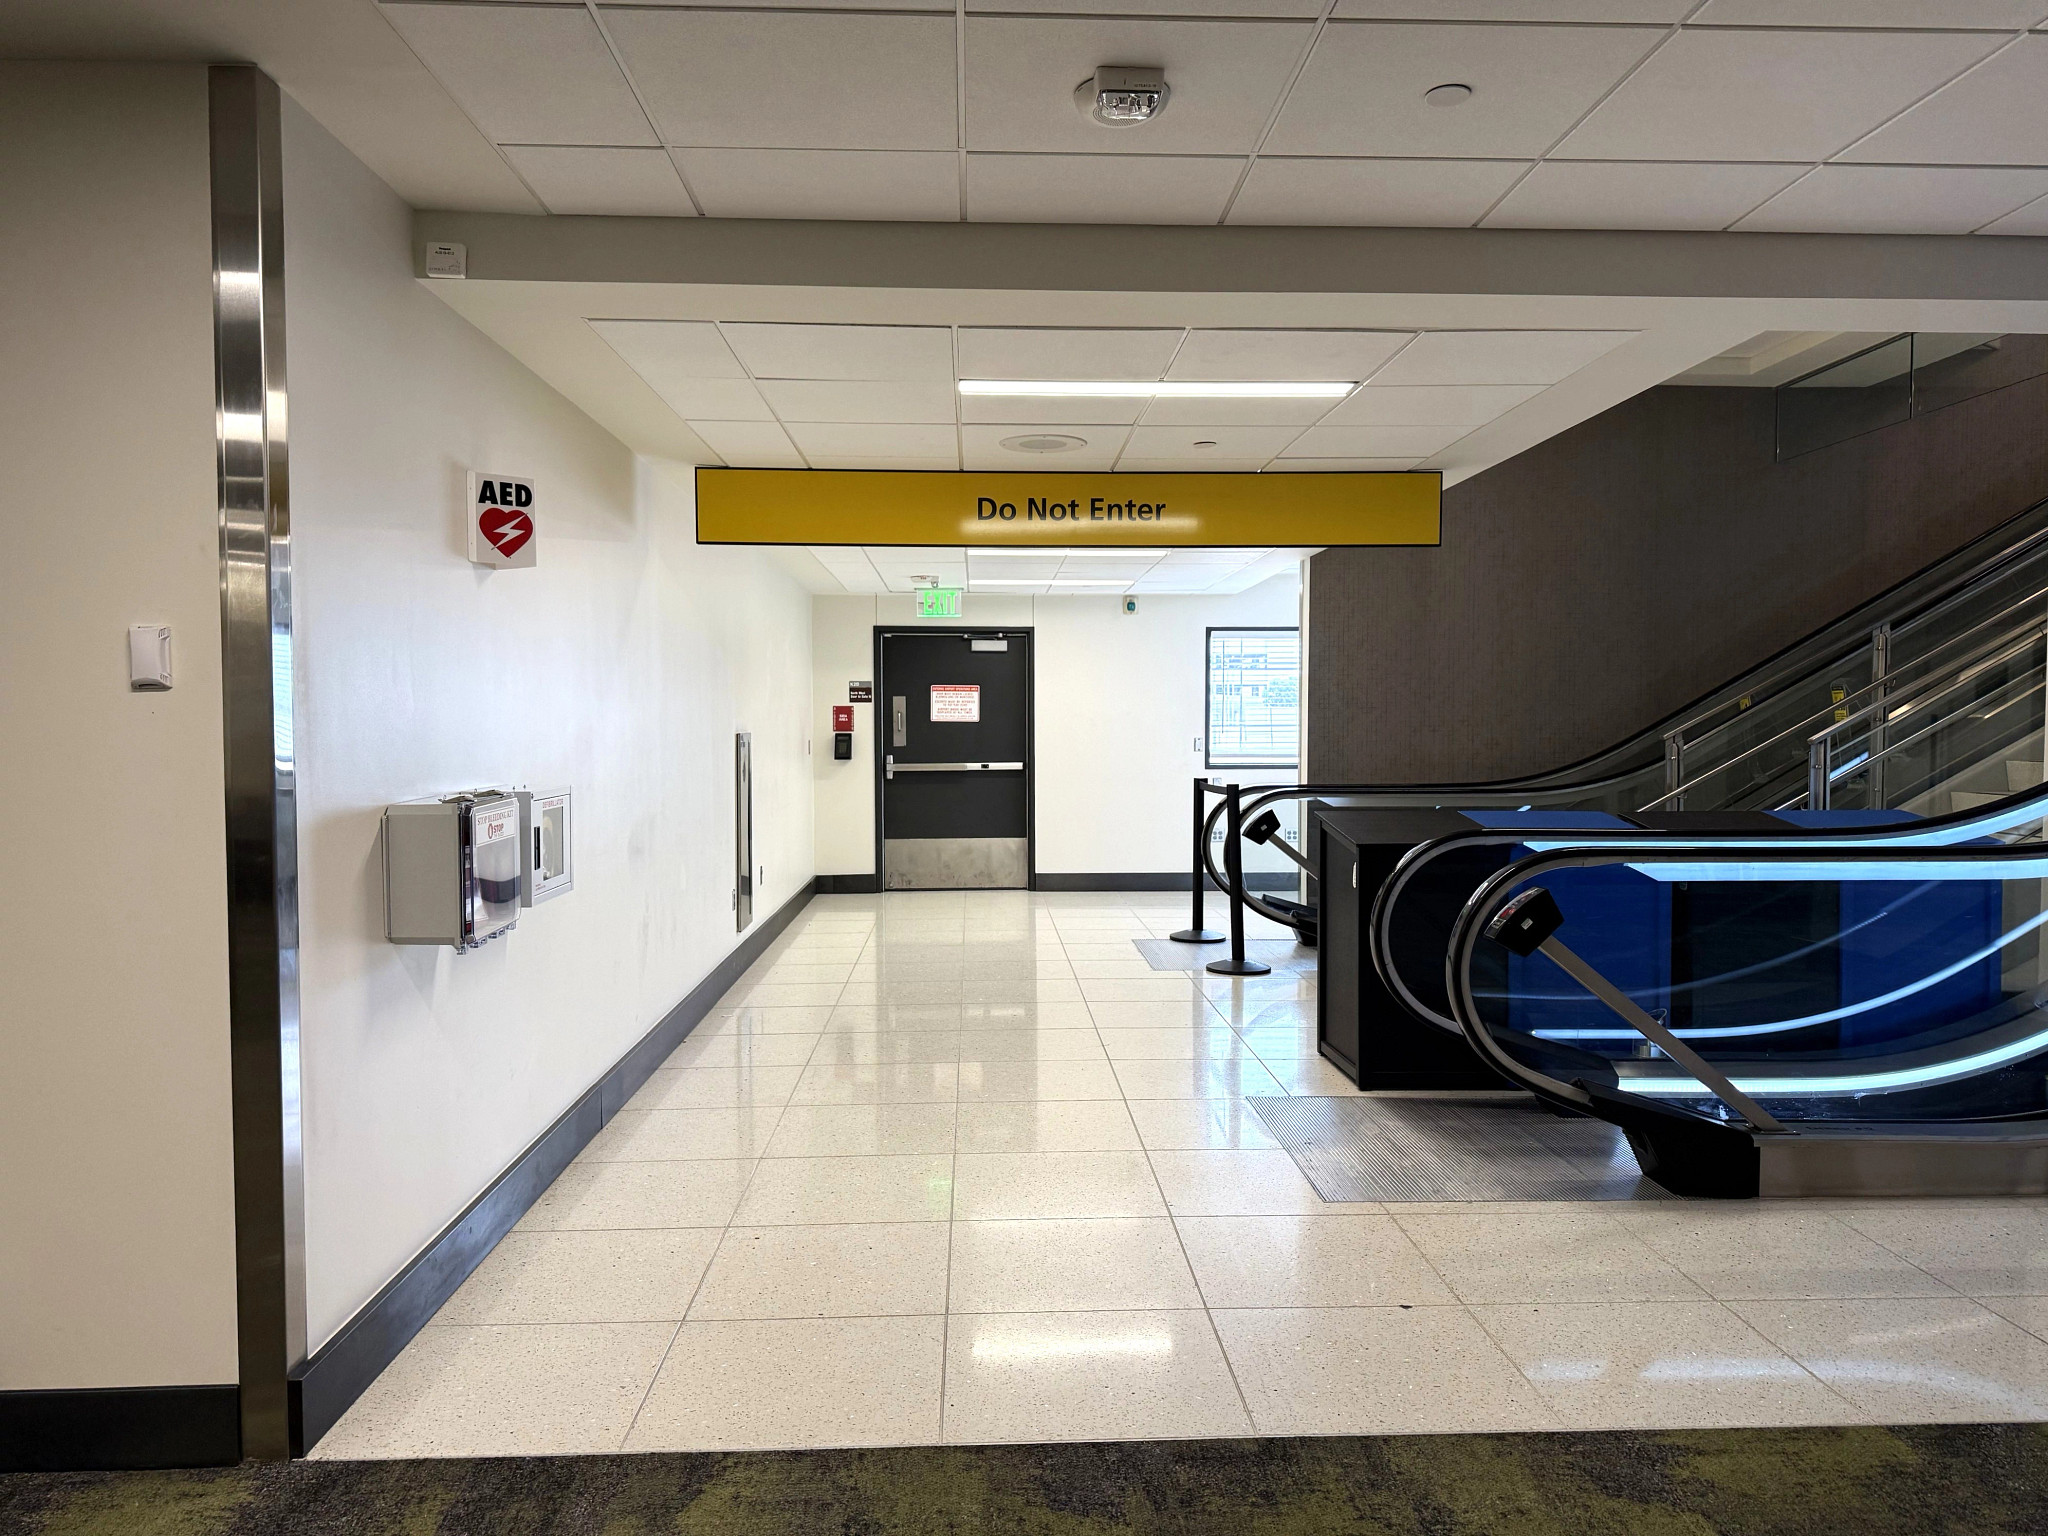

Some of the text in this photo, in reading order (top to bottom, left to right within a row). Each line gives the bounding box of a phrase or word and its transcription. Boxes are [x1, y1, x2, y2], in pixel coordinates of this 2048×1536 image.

[478, 480, 532, 507] AED
[977, 497, 1166, 521] Do Not Enter
[924, 592, 957, 615] EXIT
[493, 823, 504, 833] STOP
